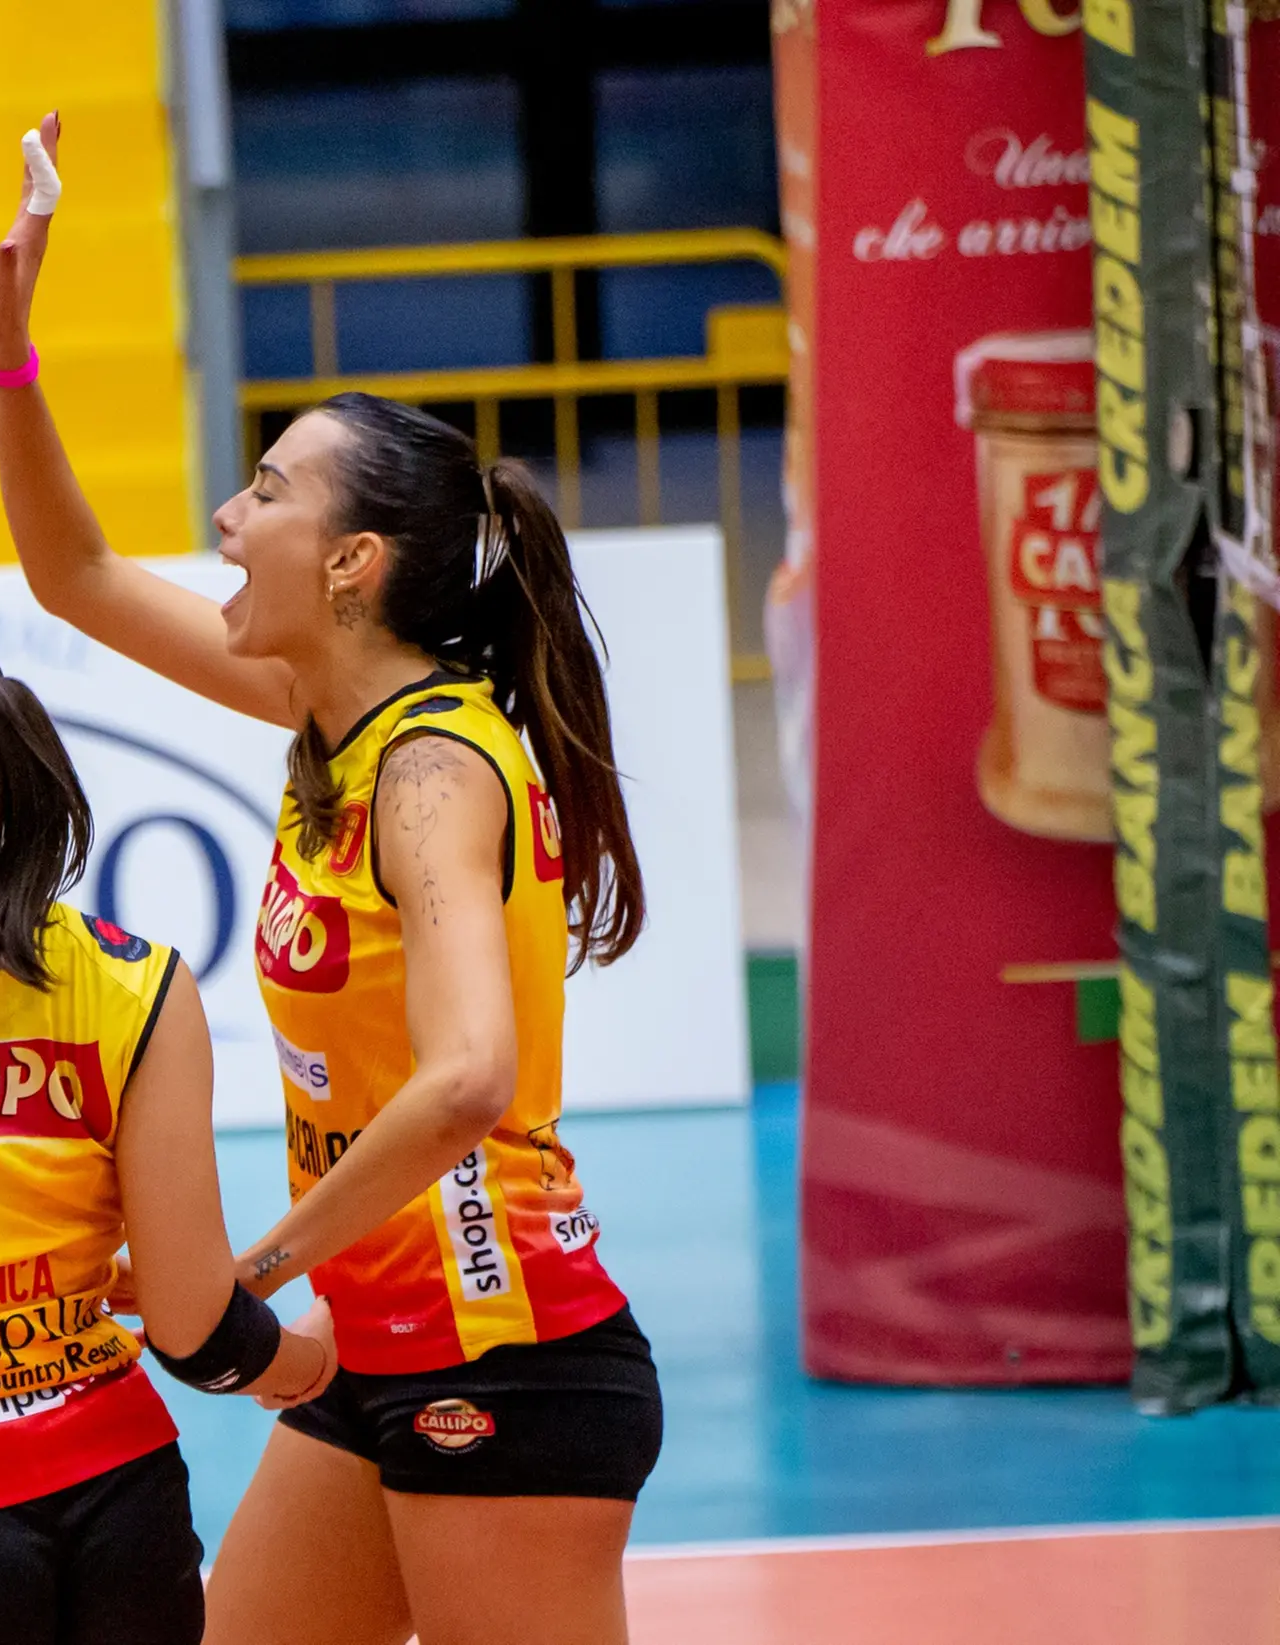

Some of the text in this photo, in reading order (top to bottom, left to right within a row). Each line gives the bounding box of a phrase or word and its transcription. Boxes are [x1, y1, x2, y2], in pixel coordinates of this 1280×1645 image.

[852, 198, 943, 262] che
[1085, 97, 1148, 514] CREDEM
[1102, 579, 1159, 933] BANCA
[418, 1412, 489, 1432] CALLIPO
